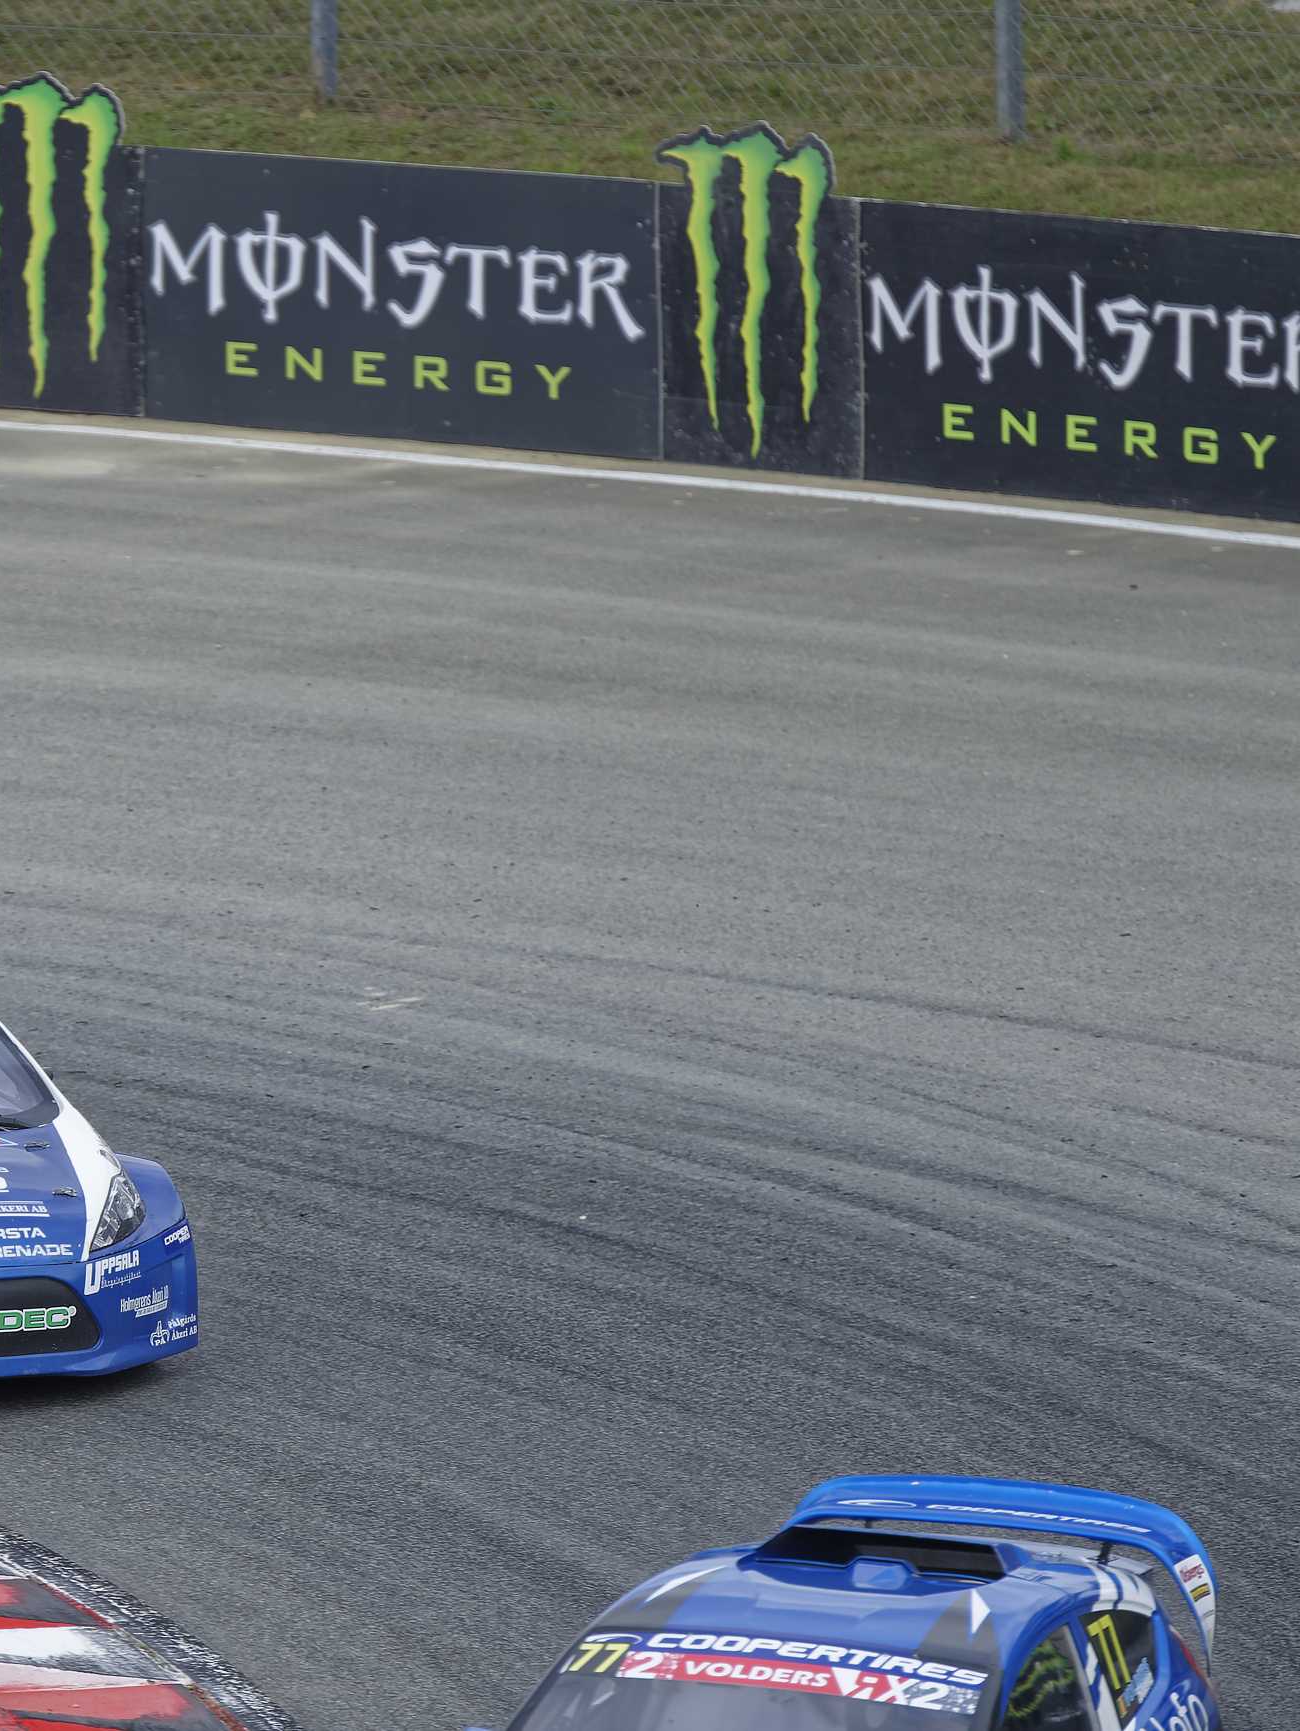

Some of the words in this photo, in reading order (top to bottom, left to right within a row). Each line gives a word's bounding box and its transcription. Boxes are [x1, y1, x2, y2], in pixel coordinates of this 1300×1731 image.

[148, 211, 645, 342] MONSTER
[225, 341, 572, 400] ENERGY
[943, 402, 1277, 470] ENERGY
[32, 1204, 48, 1213] AB
[164, 1225, 190, 1246] COOPER
[84, 1250, 140, 1296] UPPSALA
[568, 1643, 630, 1672] 77
[647, 1633, 988, 1685] COOPERTIRES
[684, 1660, 830, 1688] VOLDERS
